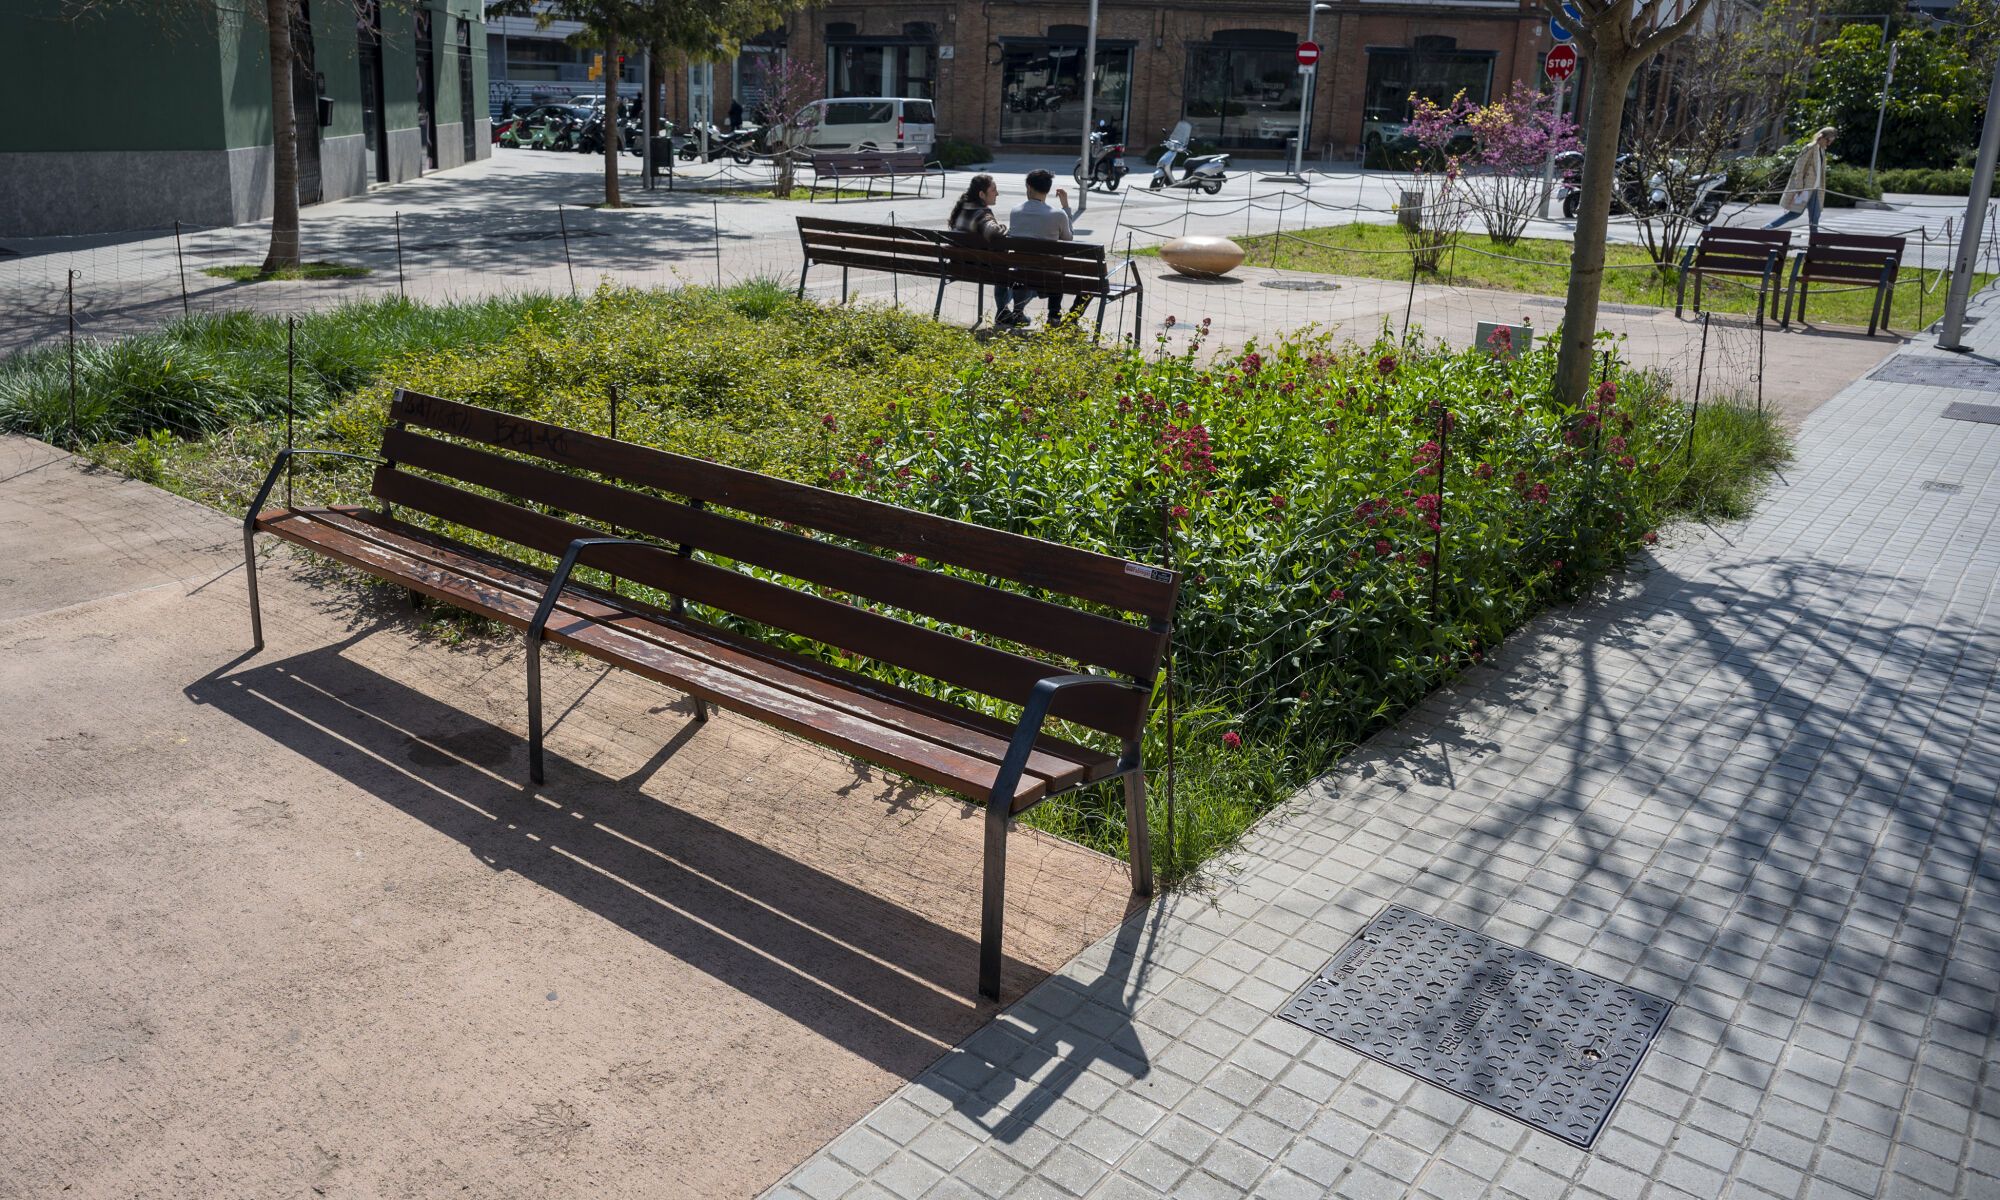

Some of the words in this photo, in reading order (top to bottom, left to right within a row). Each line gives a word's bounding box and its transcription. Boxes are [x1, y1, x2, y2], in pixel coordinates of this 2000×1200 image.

[1548, 59, 1573, 68] STOP
[1484, 966, 1517, 995] PARCS
[1451, 997, 1491, 1035] JARDINS
[1435, 1032, 1463, 1055] REG
